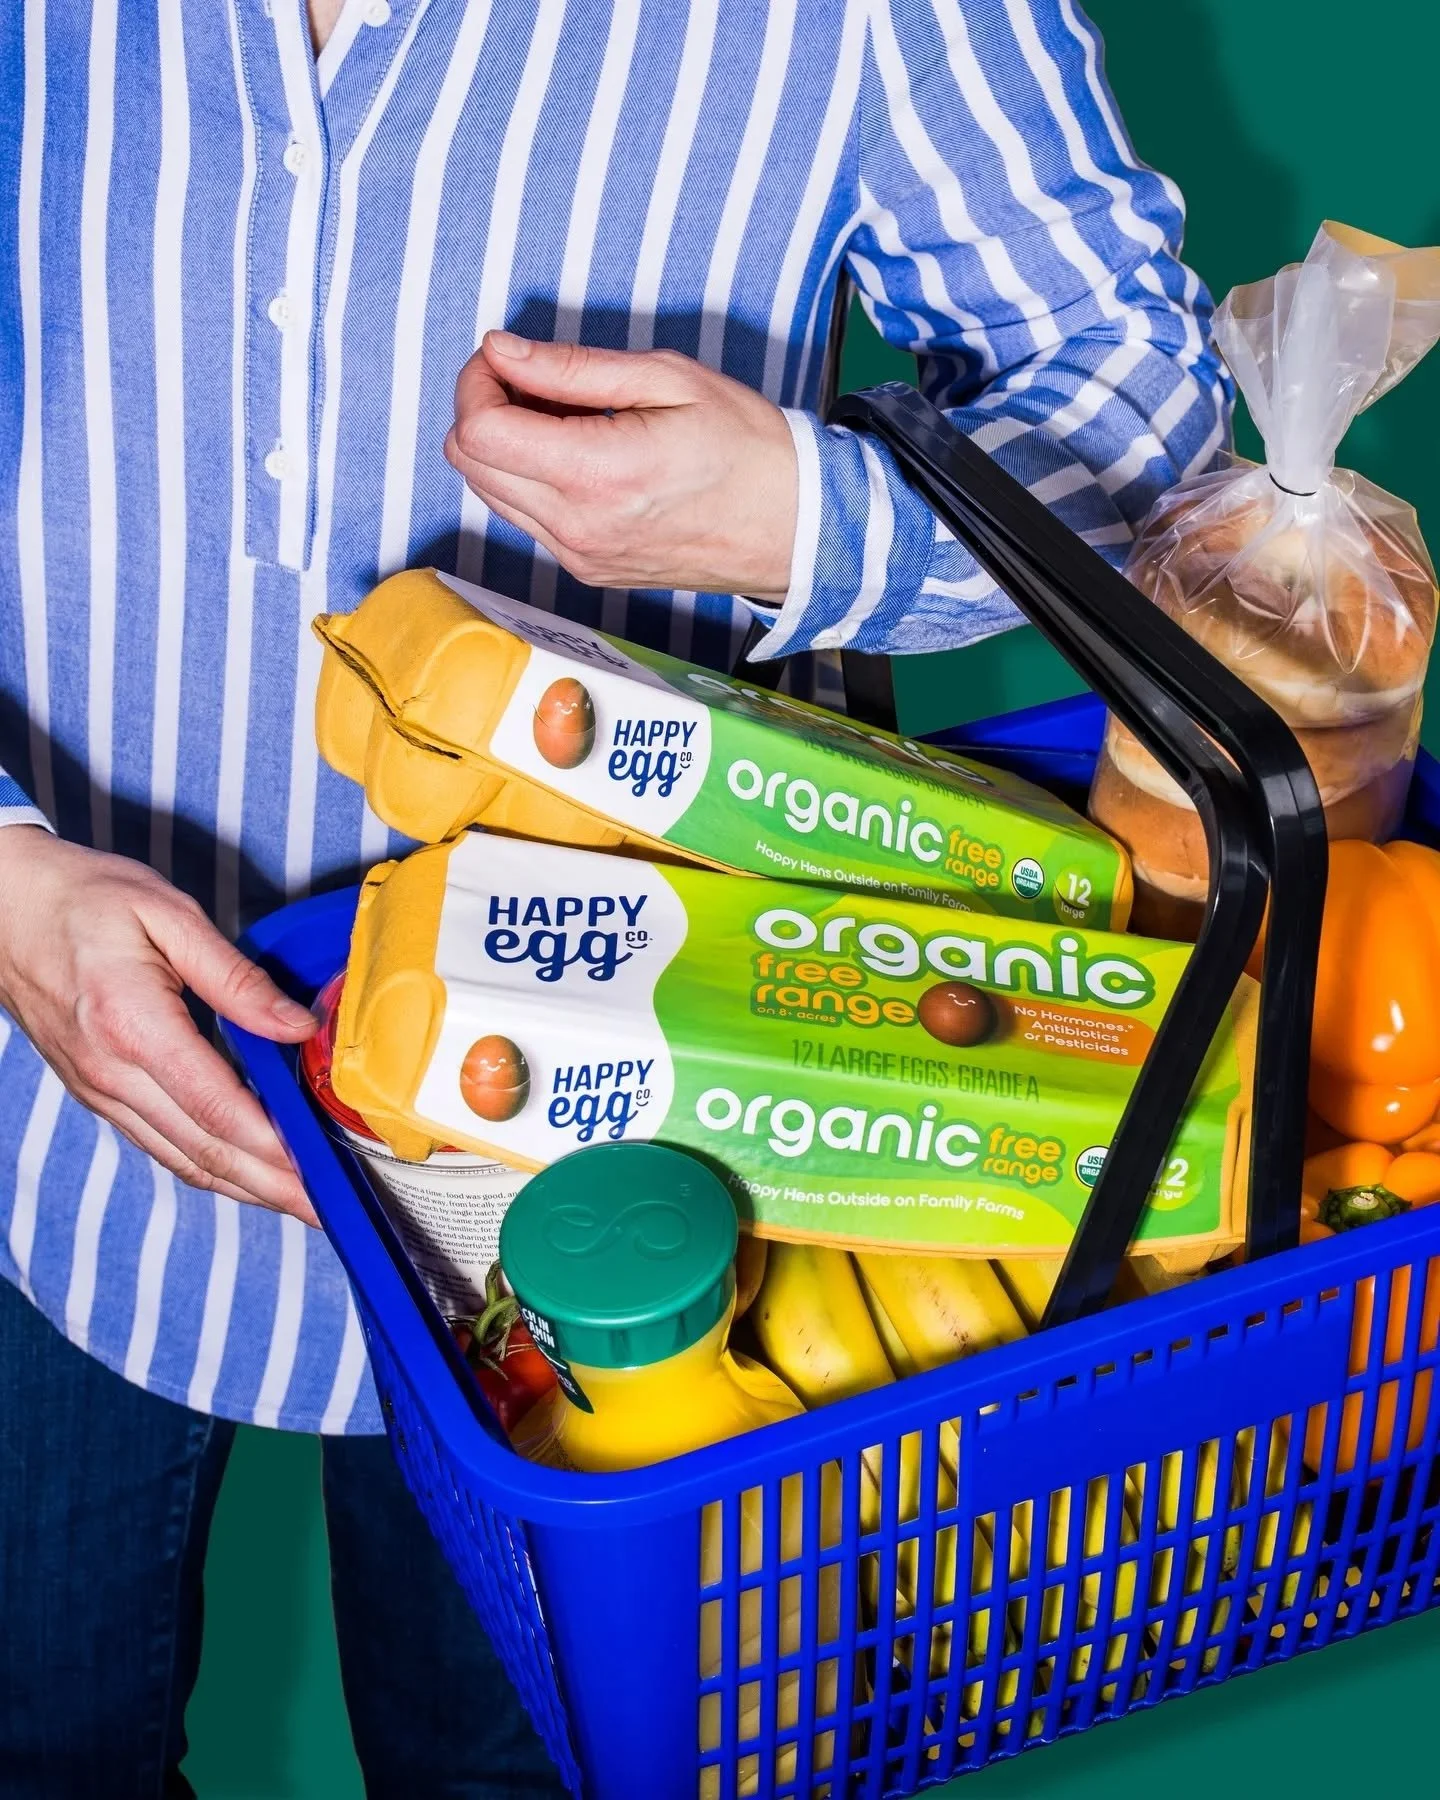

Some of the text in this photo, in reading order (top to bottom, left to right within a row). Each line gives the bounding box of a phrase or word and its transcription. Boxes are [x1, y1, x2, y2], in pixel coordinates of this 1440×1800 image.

[613, 720, 697, 747] HAPPY
[608, 749, 682, 797] egg
[727, 759, 943, 862] organic
[948, 829, 1001, 868] free
[756, 840, 797, 870] Happy
[800, 859, 832, 879] Hens
[834, 868, 881, 890] Outside
[883, 881, 898, 893] on
[901, 884, 940, 906] Family
[945, 857, 999, 887] range
[1016, 875, 1039, 890] ORGANIC
[1020, 866, 1038, 879] USDA
[1068, 873, 1091, 907] 12
[488, 895, 648, 927] HAPPY
[1061, 901, 1085, 919] large
[484, 929, 633, 982] egg
[754, 909, 1148, 1004] organic
[757, 954, 863, 986] free
[756, 984, 915, 1025] range
[757, 1006, 775, 1015] on
[797, 1012, 836, 1023] acres
[1015, 1006, 1038, 1018] No
[1025, 1032, 1129, 1056] or Pesticides
[1031, 1021, 1119, 1043] Antibiotics
[553, 1059, 654, 1093] HAPPY
[792, 1038, 1039, 1103] 12 LARGE EGGS GRADE A
[548, 1090, 638, 1142] egg
[696, 1088, 981, 1167] organic
[989, 1127, 1061, 1162] free
[982, 1156, 1058, 1183] range
[1081, 1167, 1100, 1176] ORGA
[1087, 1155, 1104, 1165] USD
[401, 1182, 419, 1193] upon
[728, 1173, 1025, 1220] Happy Hens Outside on Family Farms
[450, 1209, 473, 1217] single
[468, 1202, 496, 1210] locally
[438, 1214, 451, 1223] the
[451, 1217, 472, 1225] same
[473, 1218, 494, 1226] good
[442, 1232, 457, 1240] and
[458, 1233, 487, 1243] sharing
[444, 1241, 483, 1250] wonderful
[452, 1248, 479, 1257] believe
[480, 1251, 494, 1259] you
[529, 1321, 555, 1349] AMIN
[537, 1316, 549, 1334] IN
